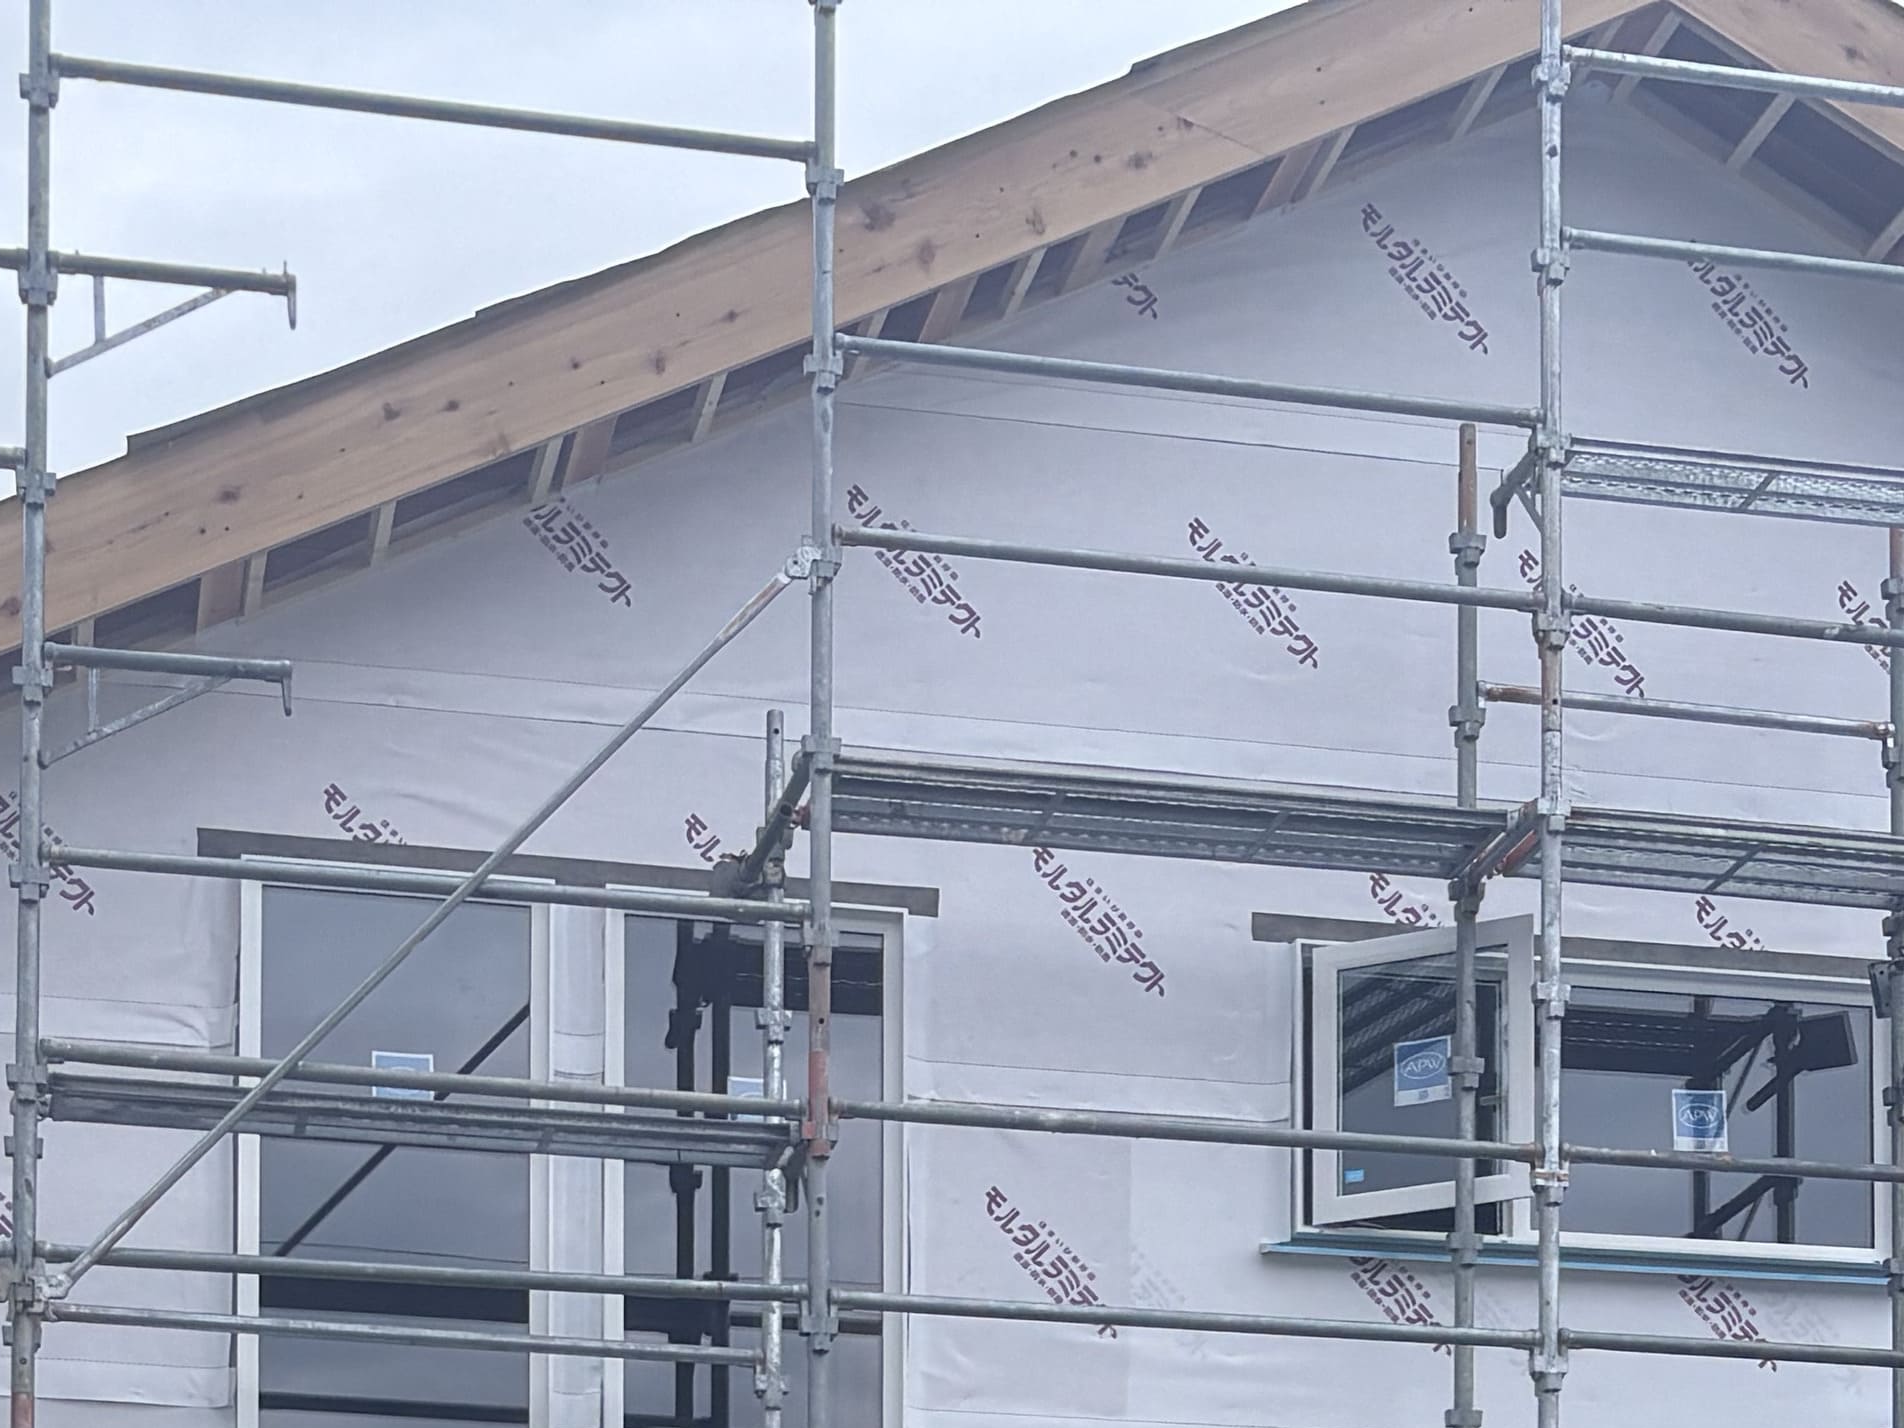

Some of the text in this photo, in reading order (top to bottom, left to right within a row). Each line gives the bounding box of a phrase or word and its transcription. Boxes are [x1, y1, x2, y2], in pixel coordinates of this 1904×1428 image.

[1360, 203, 1489, 355] モルタルラミテクト
